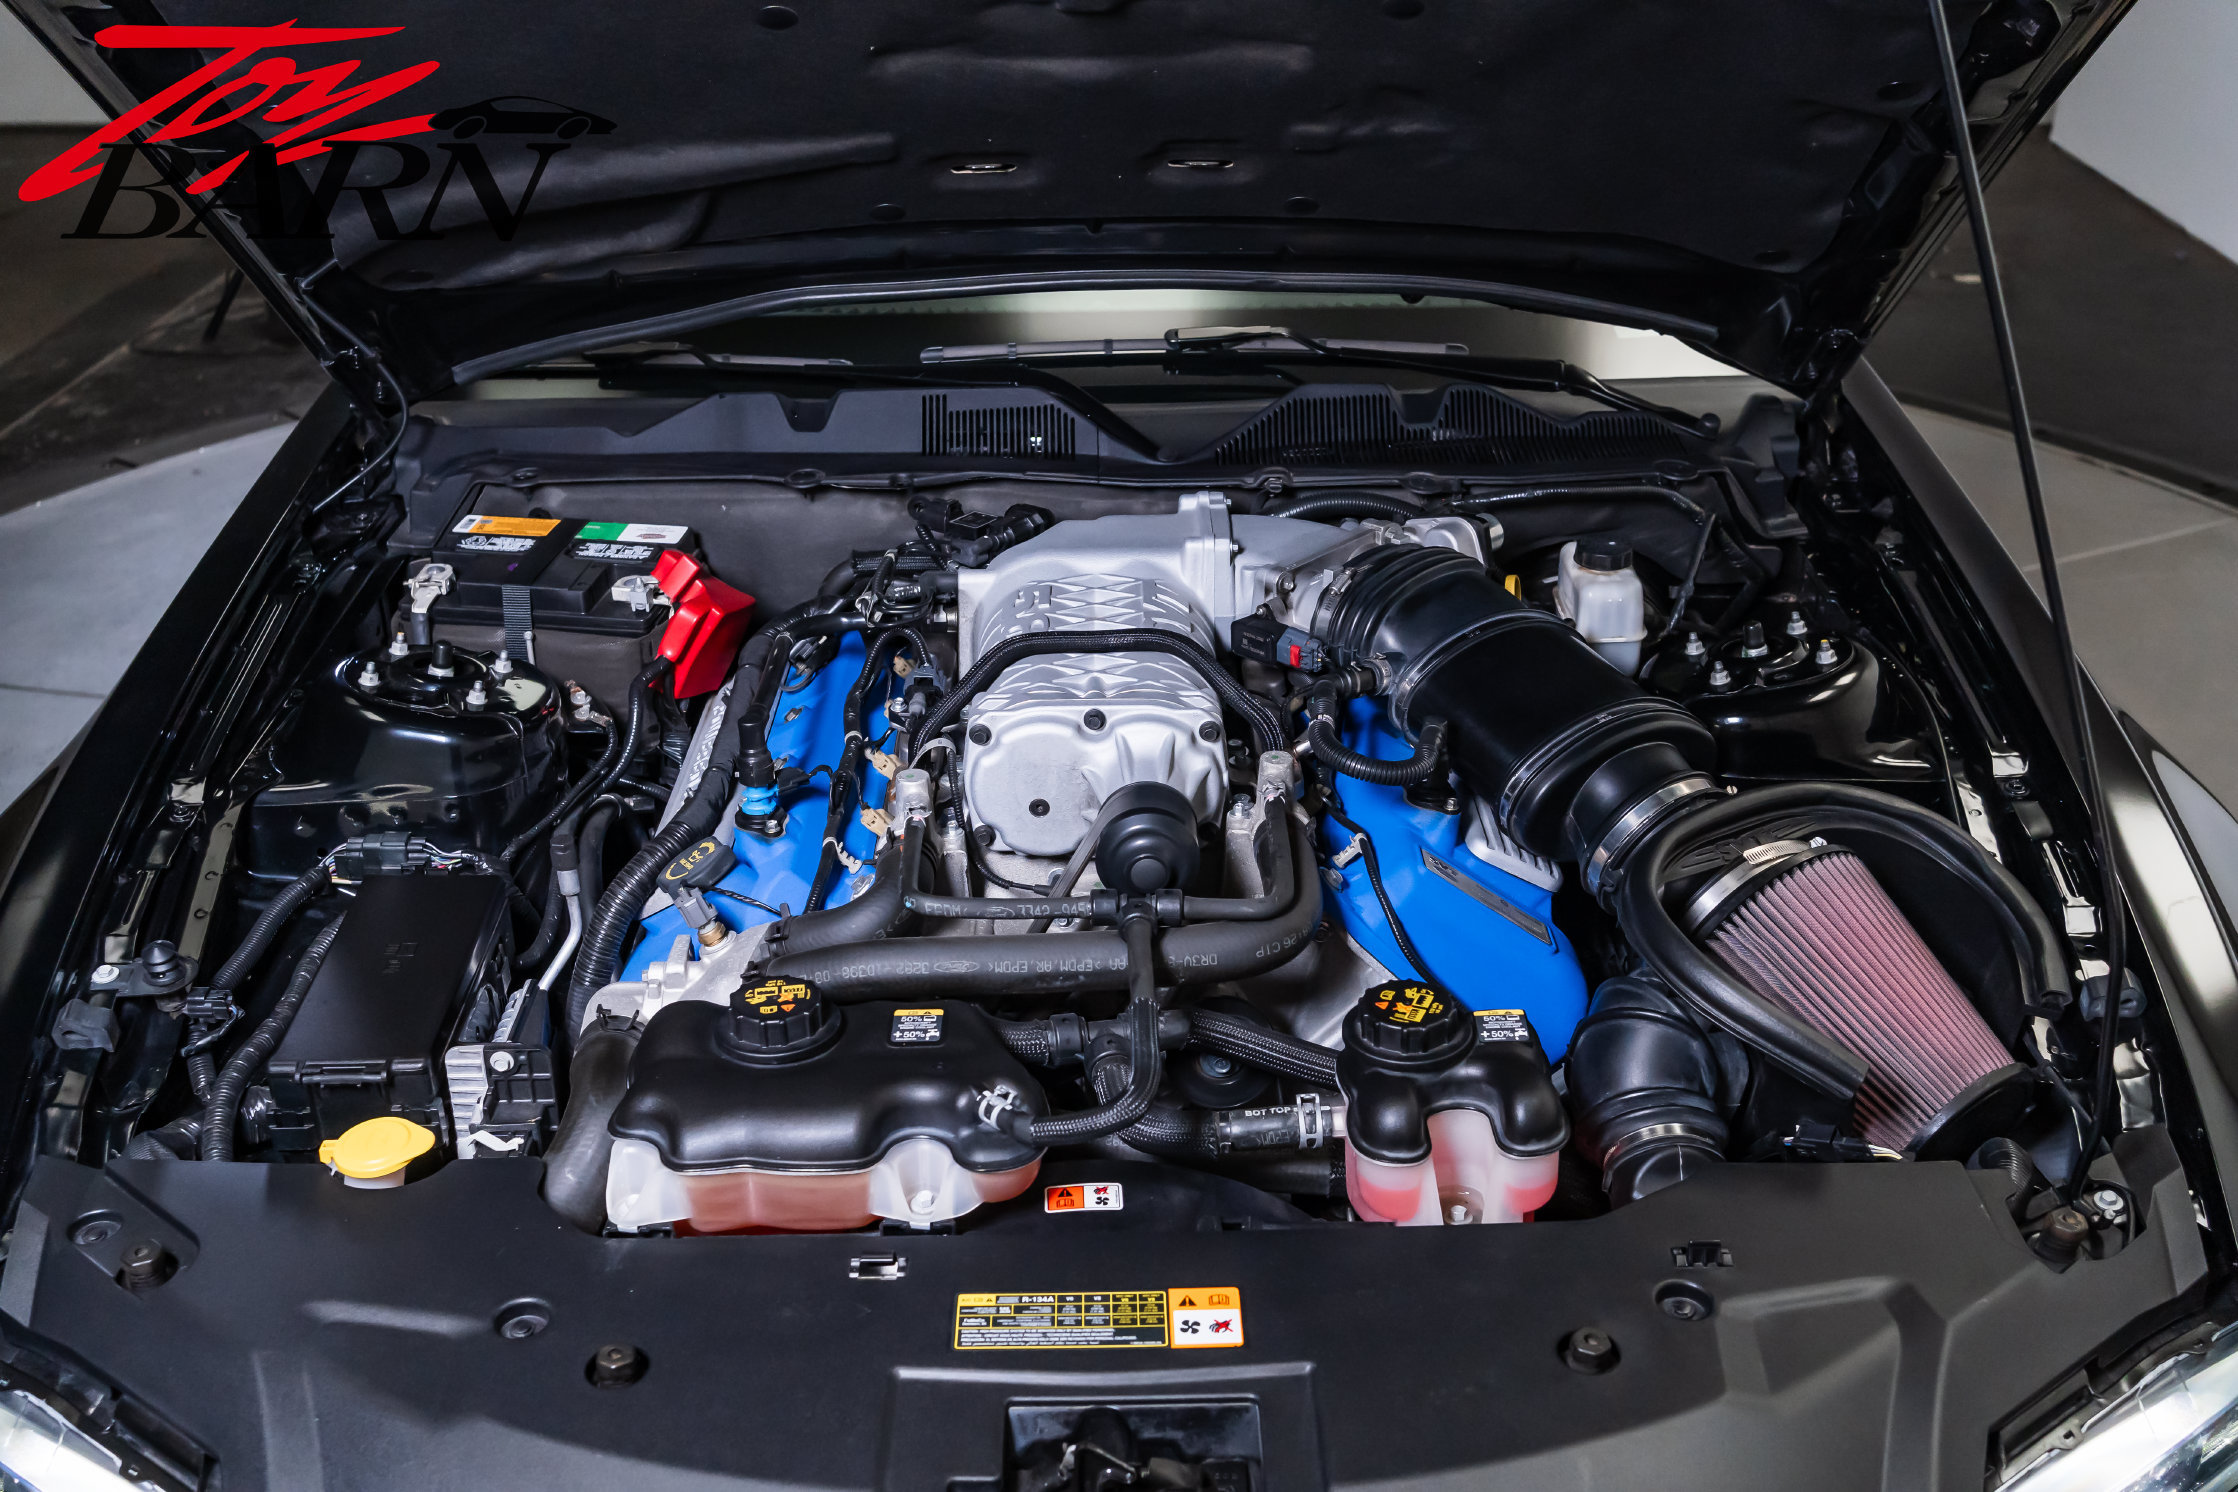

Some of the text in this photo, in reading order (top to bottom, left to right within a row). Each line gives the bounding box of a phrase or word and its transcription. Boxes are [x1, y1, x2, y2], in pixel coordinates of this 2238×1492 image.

[1245, 1106, 1291, 1117] BOT TOP
[1021, 1295, 1055, 1304] R-134A
